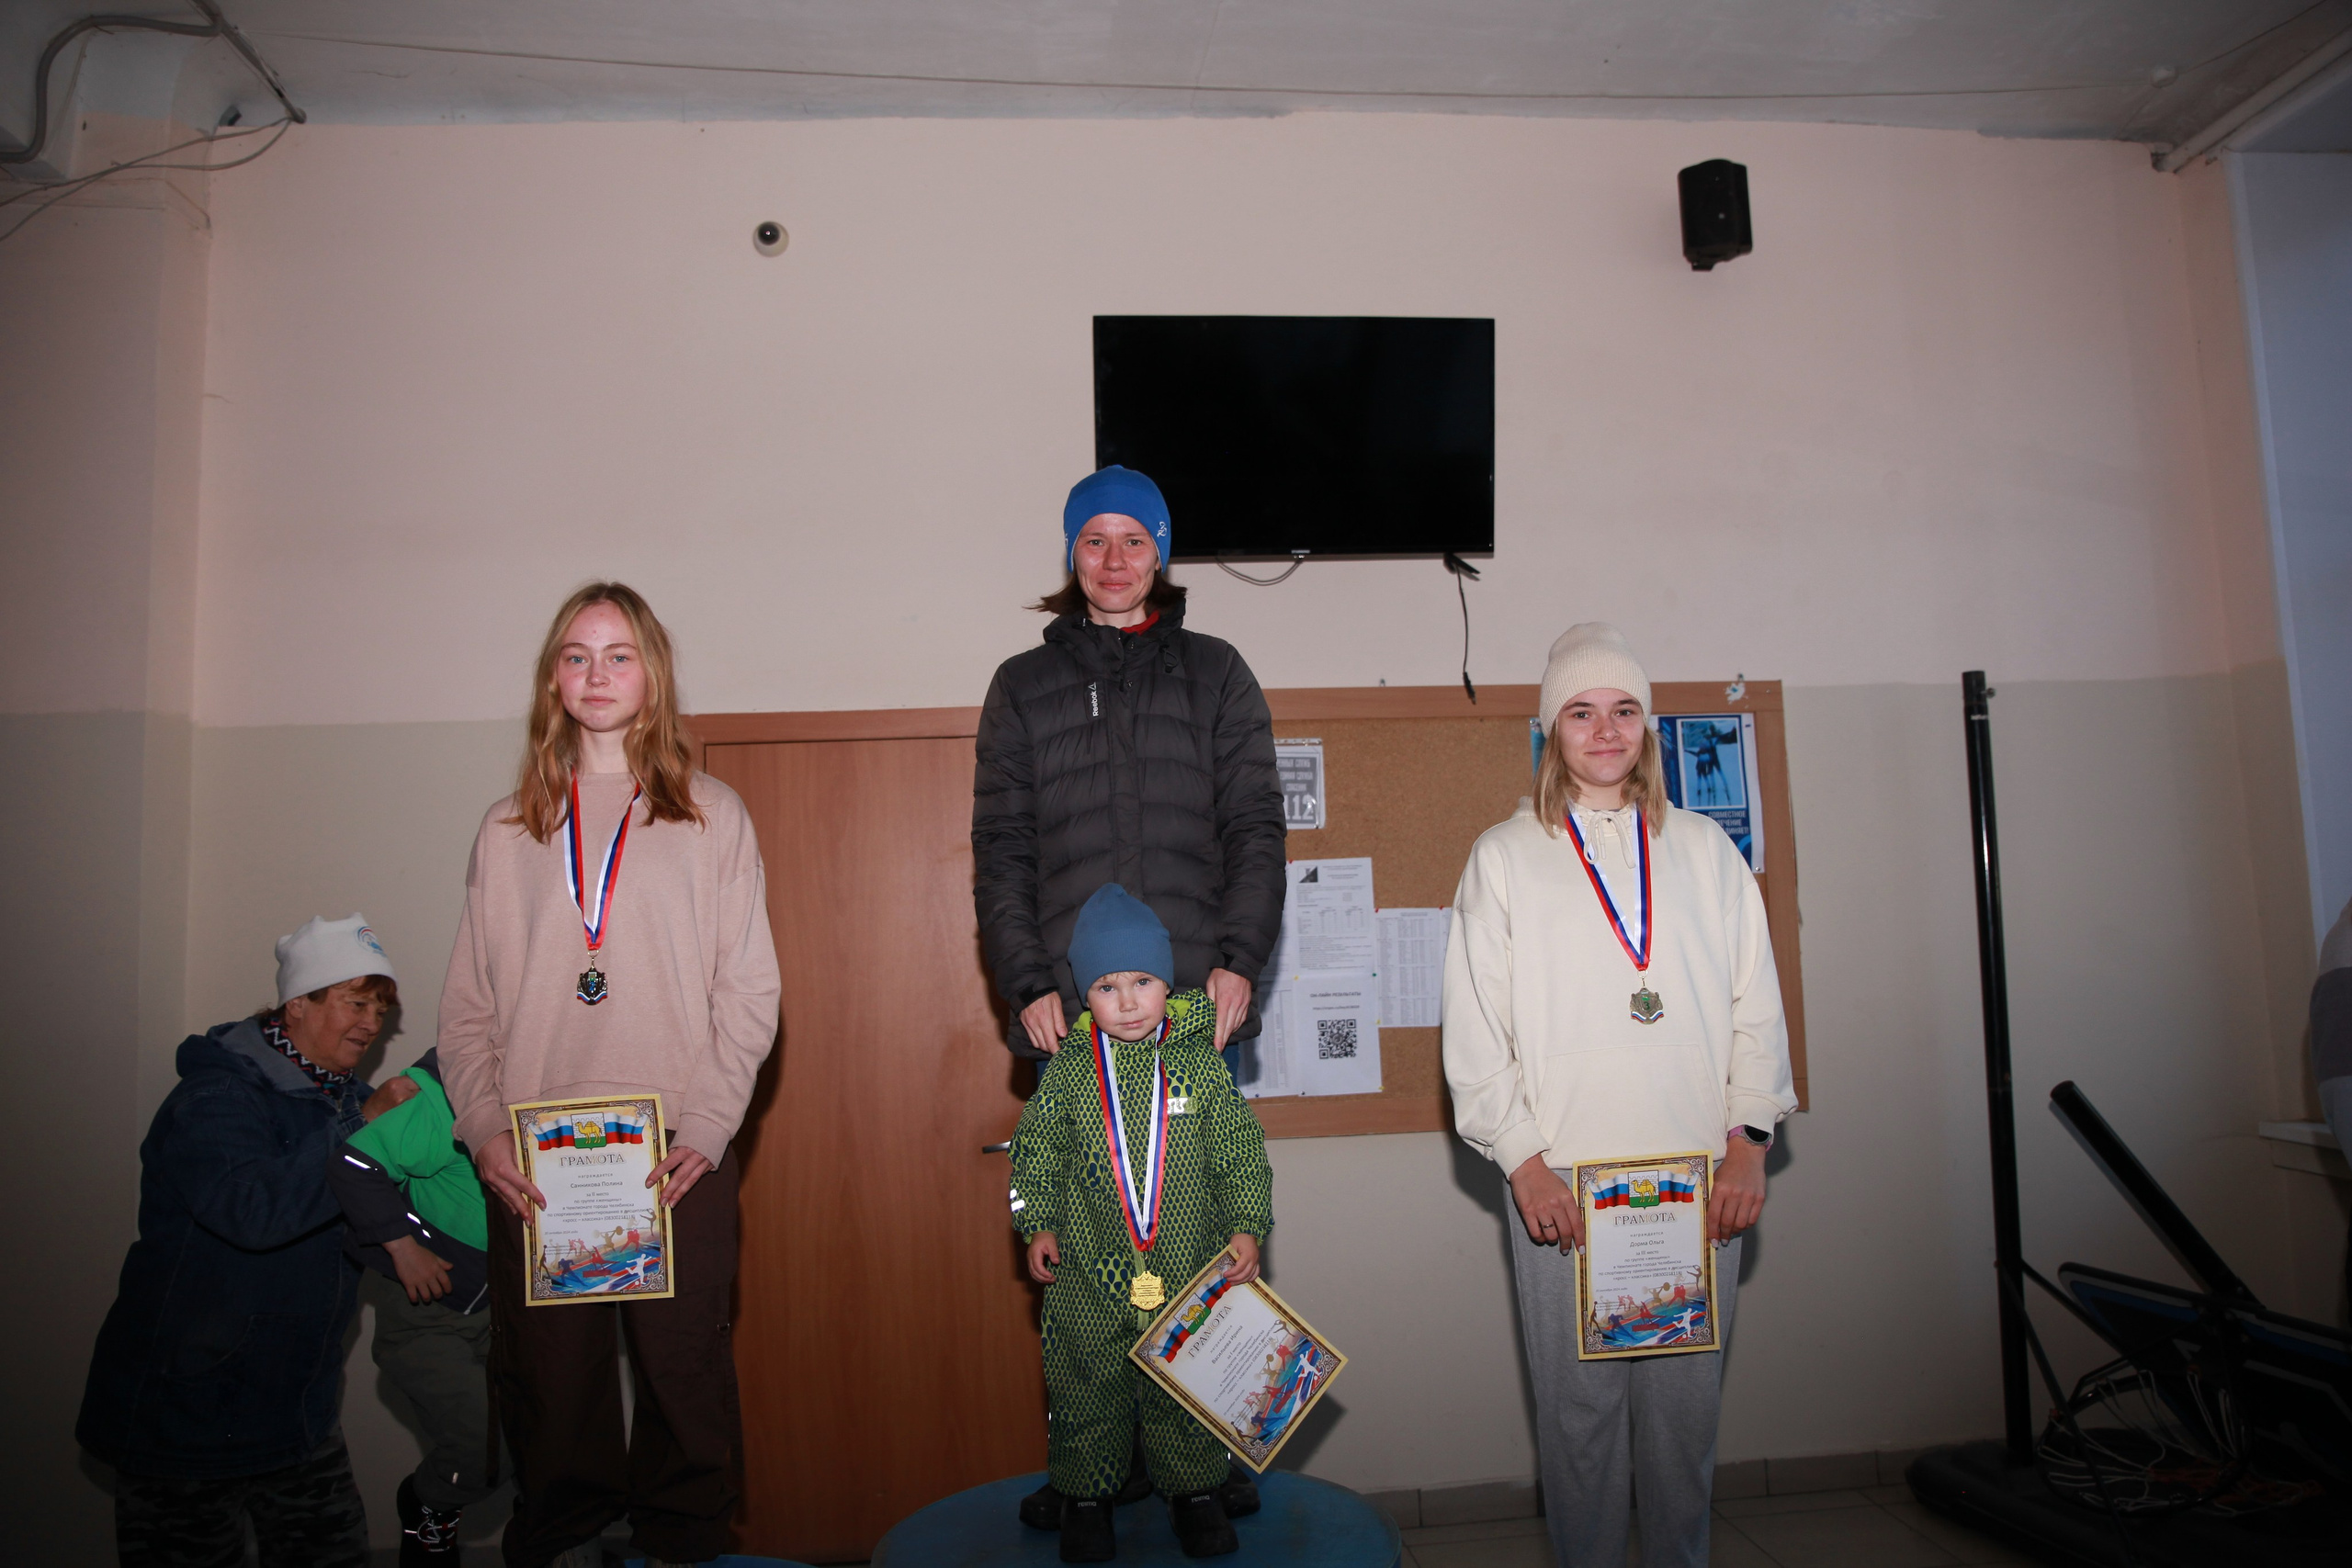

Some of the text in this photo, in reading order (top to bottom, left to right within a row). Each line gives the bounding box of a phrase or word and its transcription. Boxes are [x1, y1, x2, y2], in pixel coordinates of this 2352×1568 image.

[1091, 690, 1099, 716] Reebok
[1283, 795, 1315, 820] 112
[1644, 1002, 1651, 1010] 3
[560, 1153, 624, 1167] ГРАМОТА
[1615, 1212, 1675, 1225] ГРАМОТА
[1188, 1304, 1232, 1358] ГРАМОТА
[1191, 1495, 1210, 1503] reima
